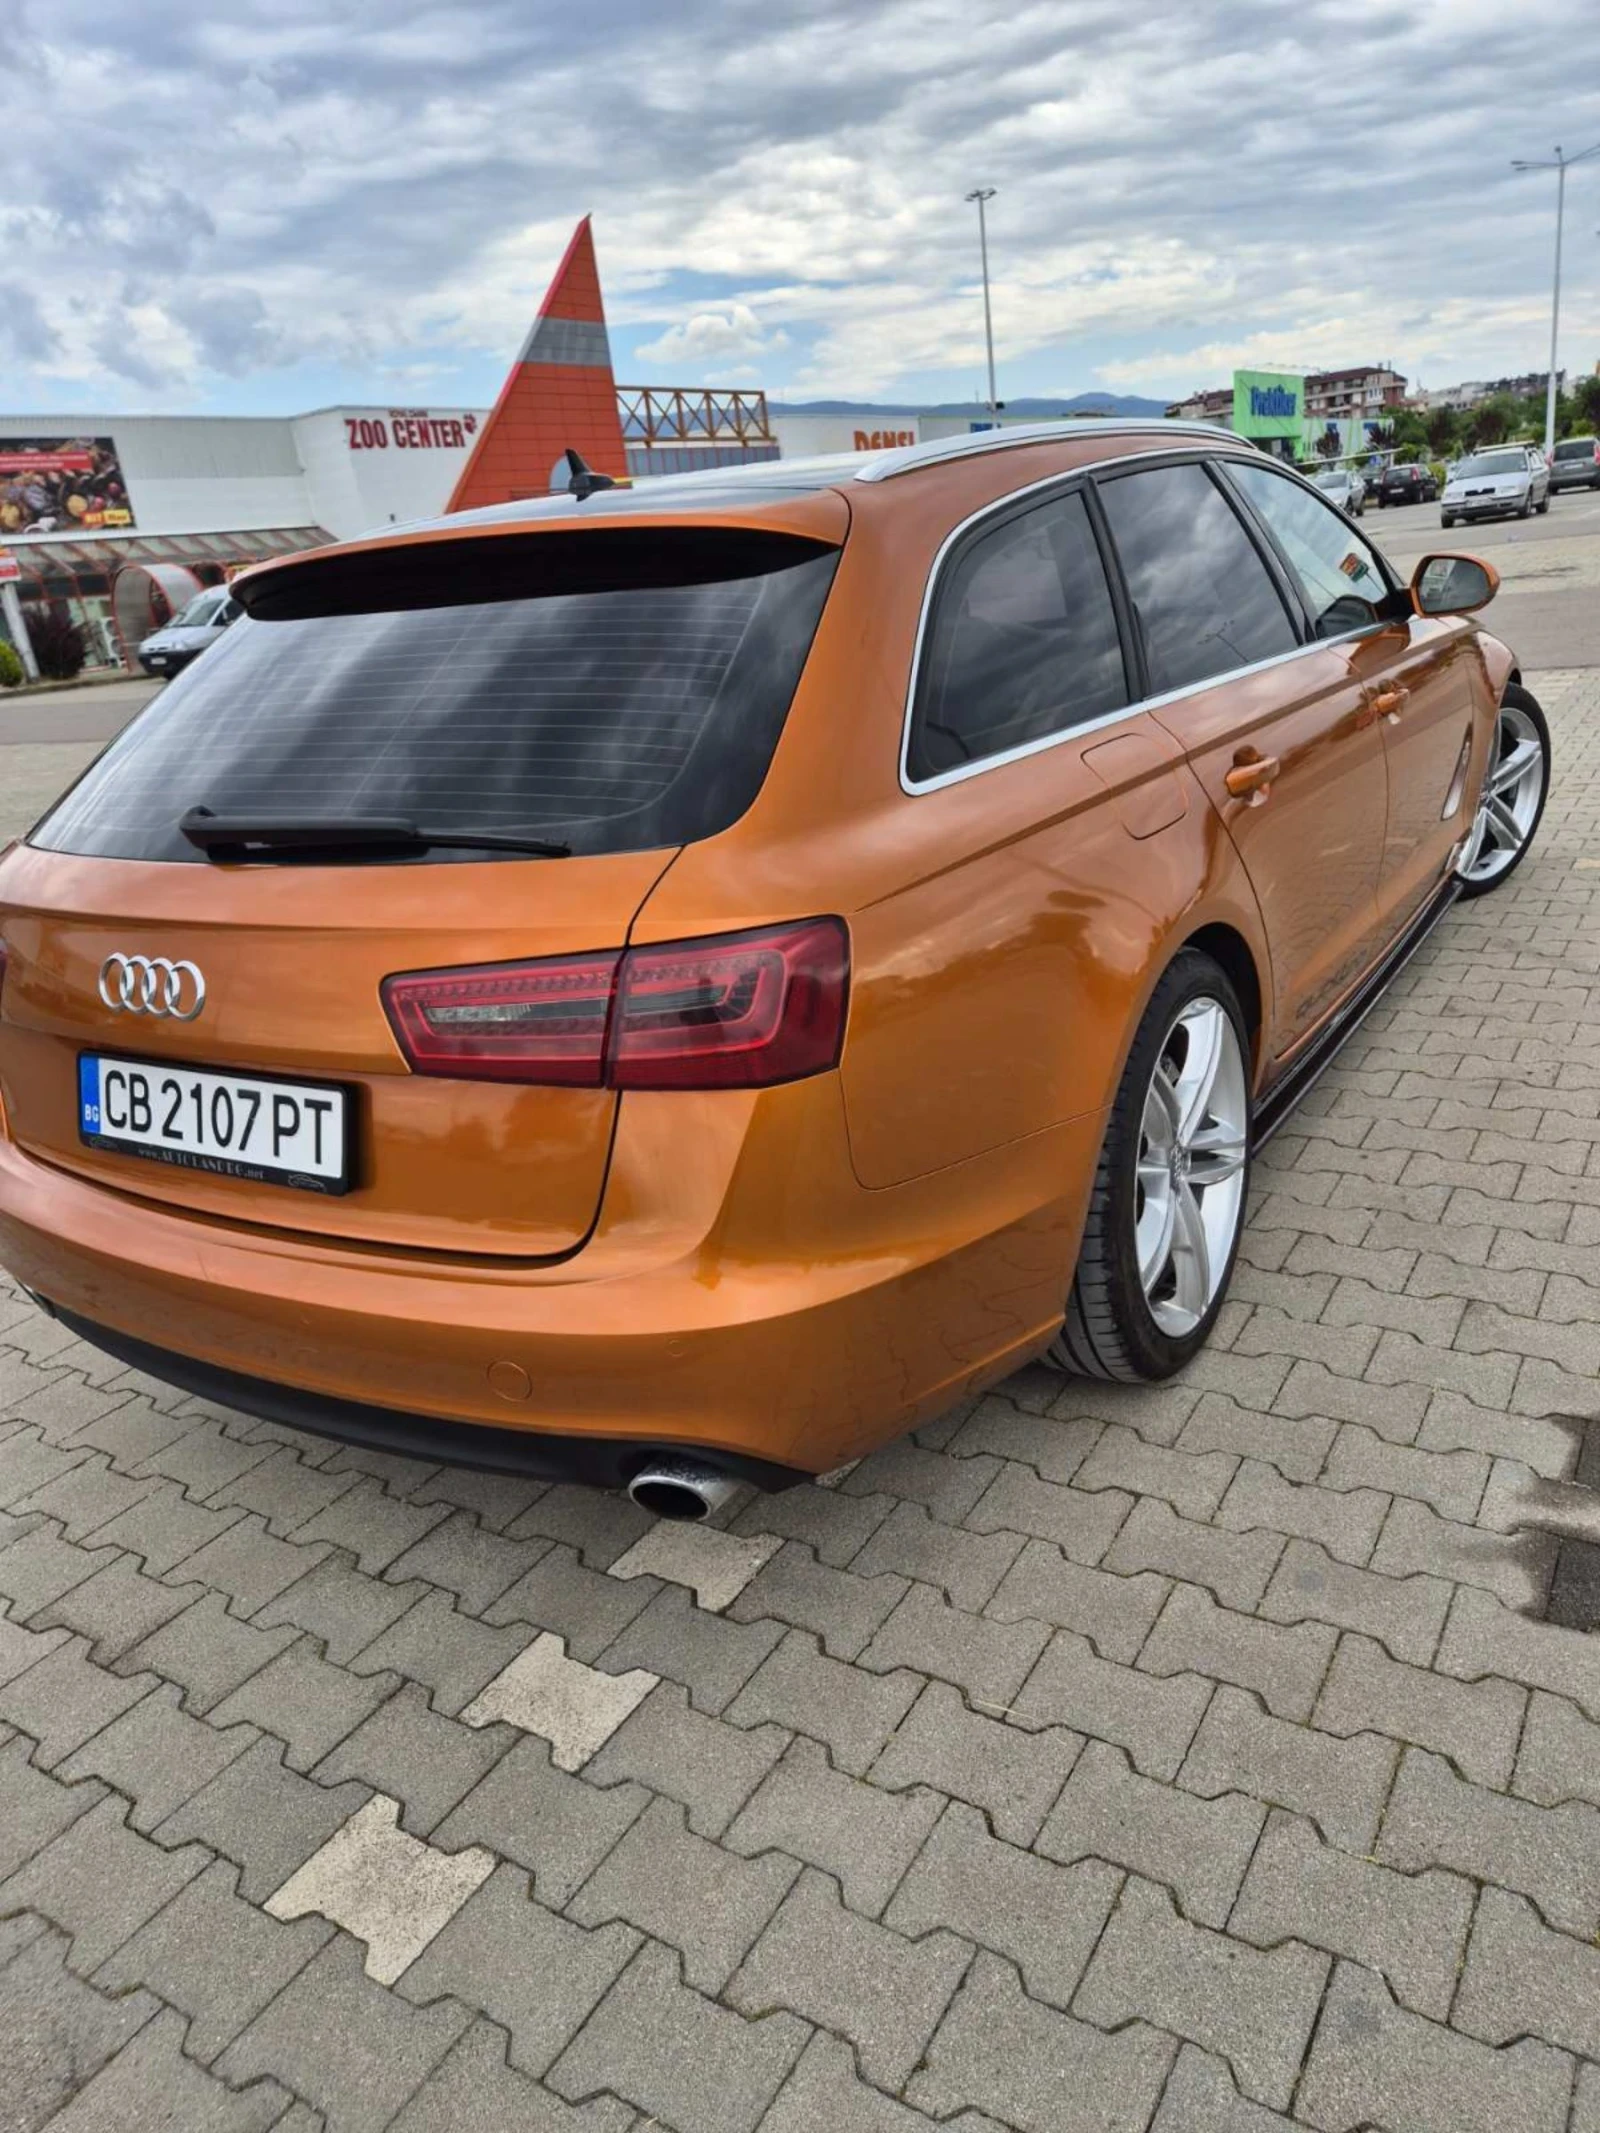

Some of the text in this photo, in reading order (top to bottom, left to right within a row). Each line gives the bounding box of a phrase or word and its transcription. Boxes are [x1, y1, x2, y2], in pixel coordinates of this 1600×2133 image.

[344, 418, 466, 448] ZOO CENTER
[84, 1104, 99, 1122] BG
